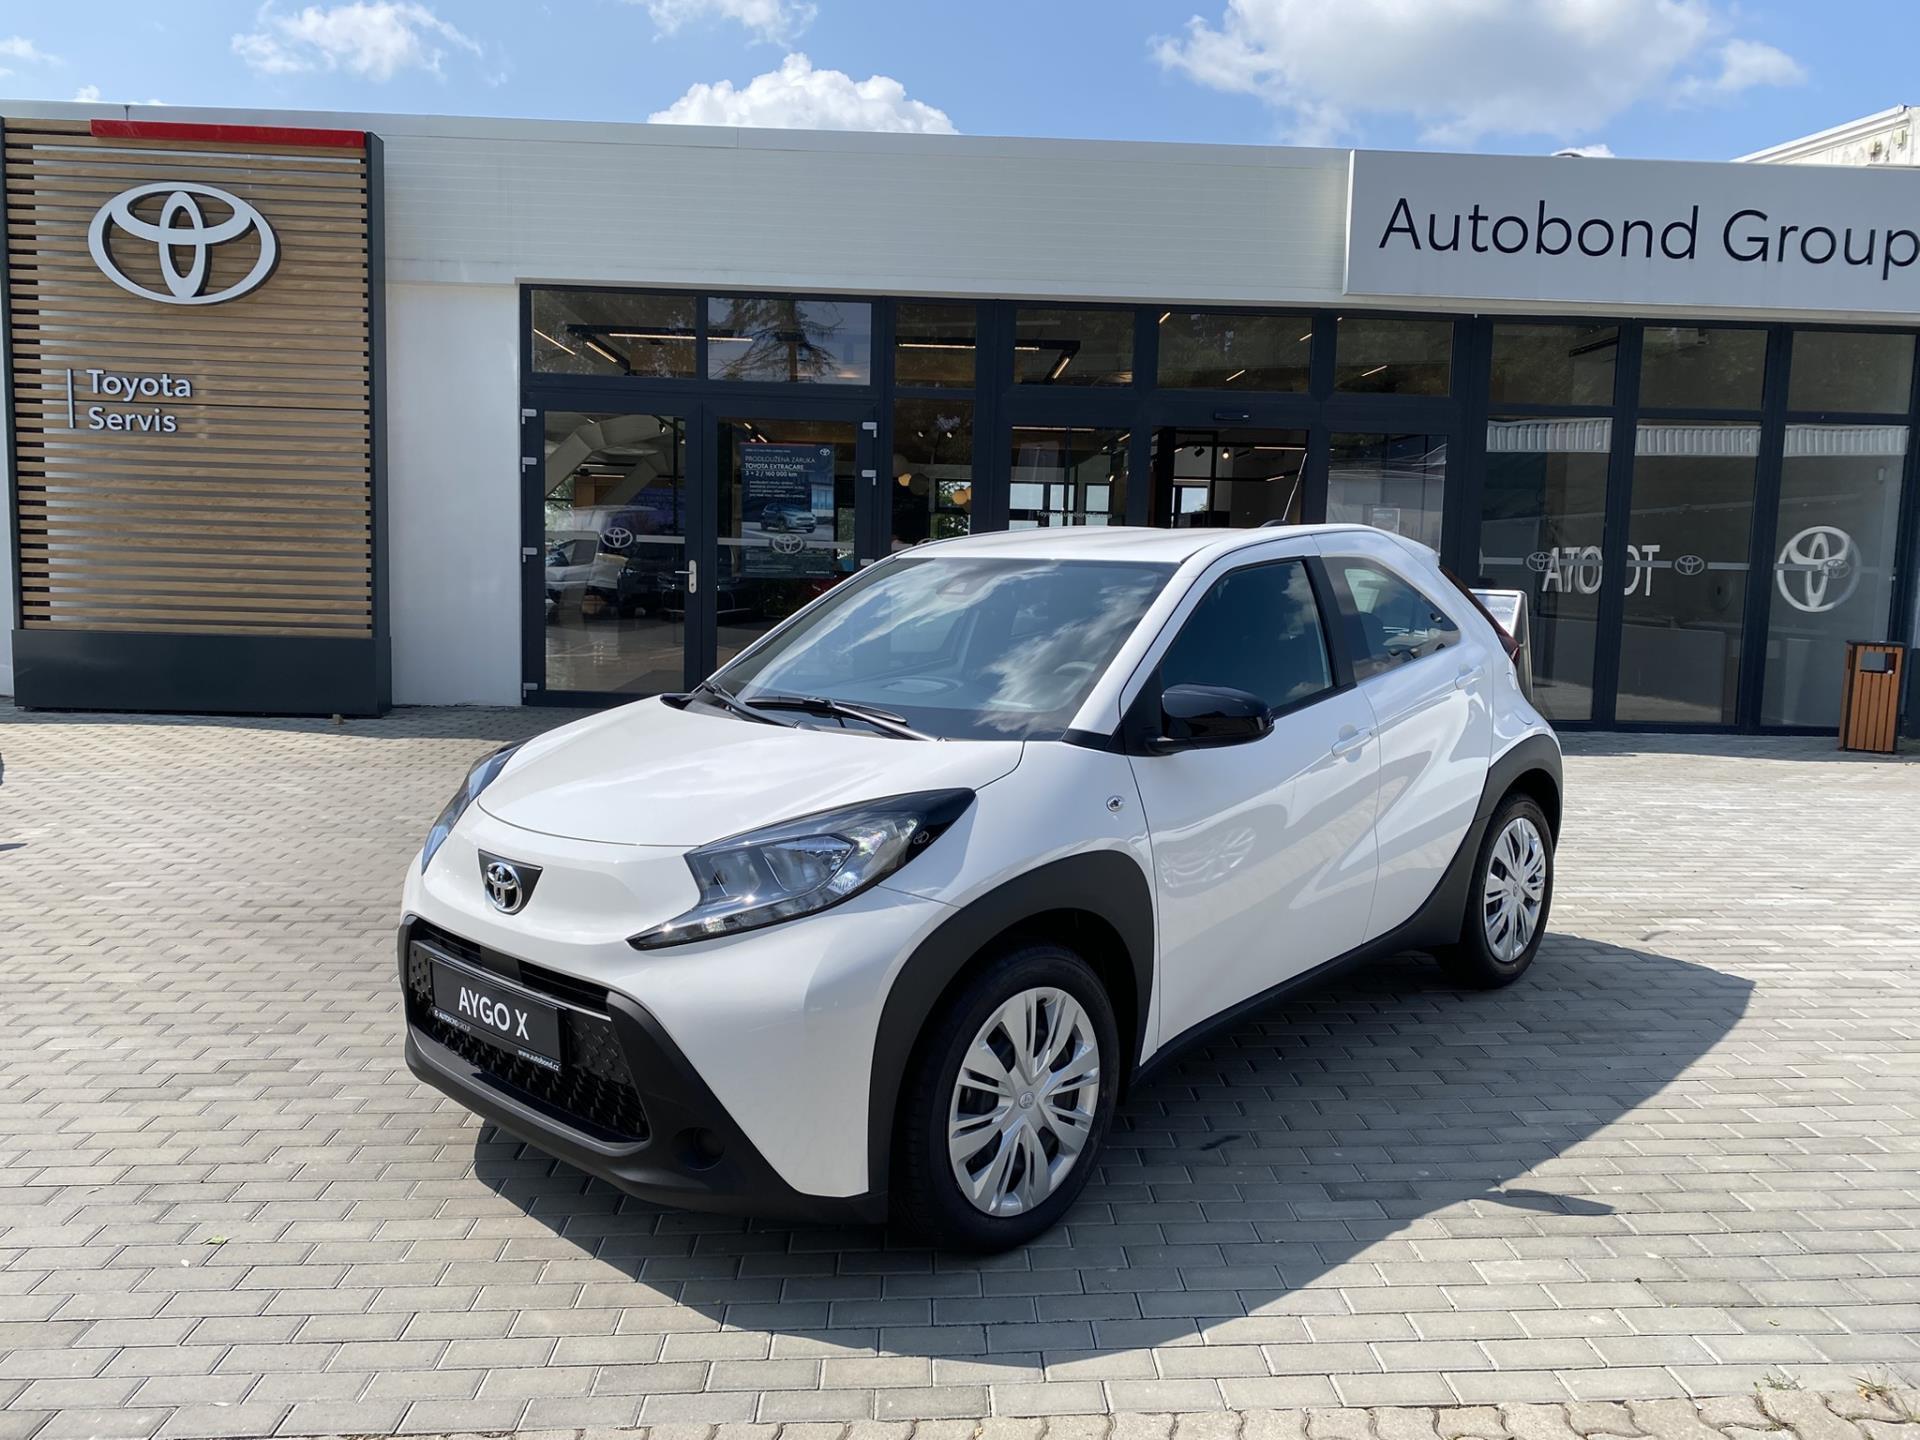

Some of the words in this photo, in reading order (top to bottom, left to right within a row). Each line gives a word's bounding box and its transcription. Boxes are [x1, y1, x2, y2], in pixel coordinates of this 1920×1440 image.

[1379, 197, 1700, 260] Autobond
[1723, 208, 1920, 281] Group
[86, 369, 192, 402] Toyota
[88, 406, 177, 432] Servis
[458, 986, 511, 1032] AYGO
[514, 1009, 530, 1040] X
